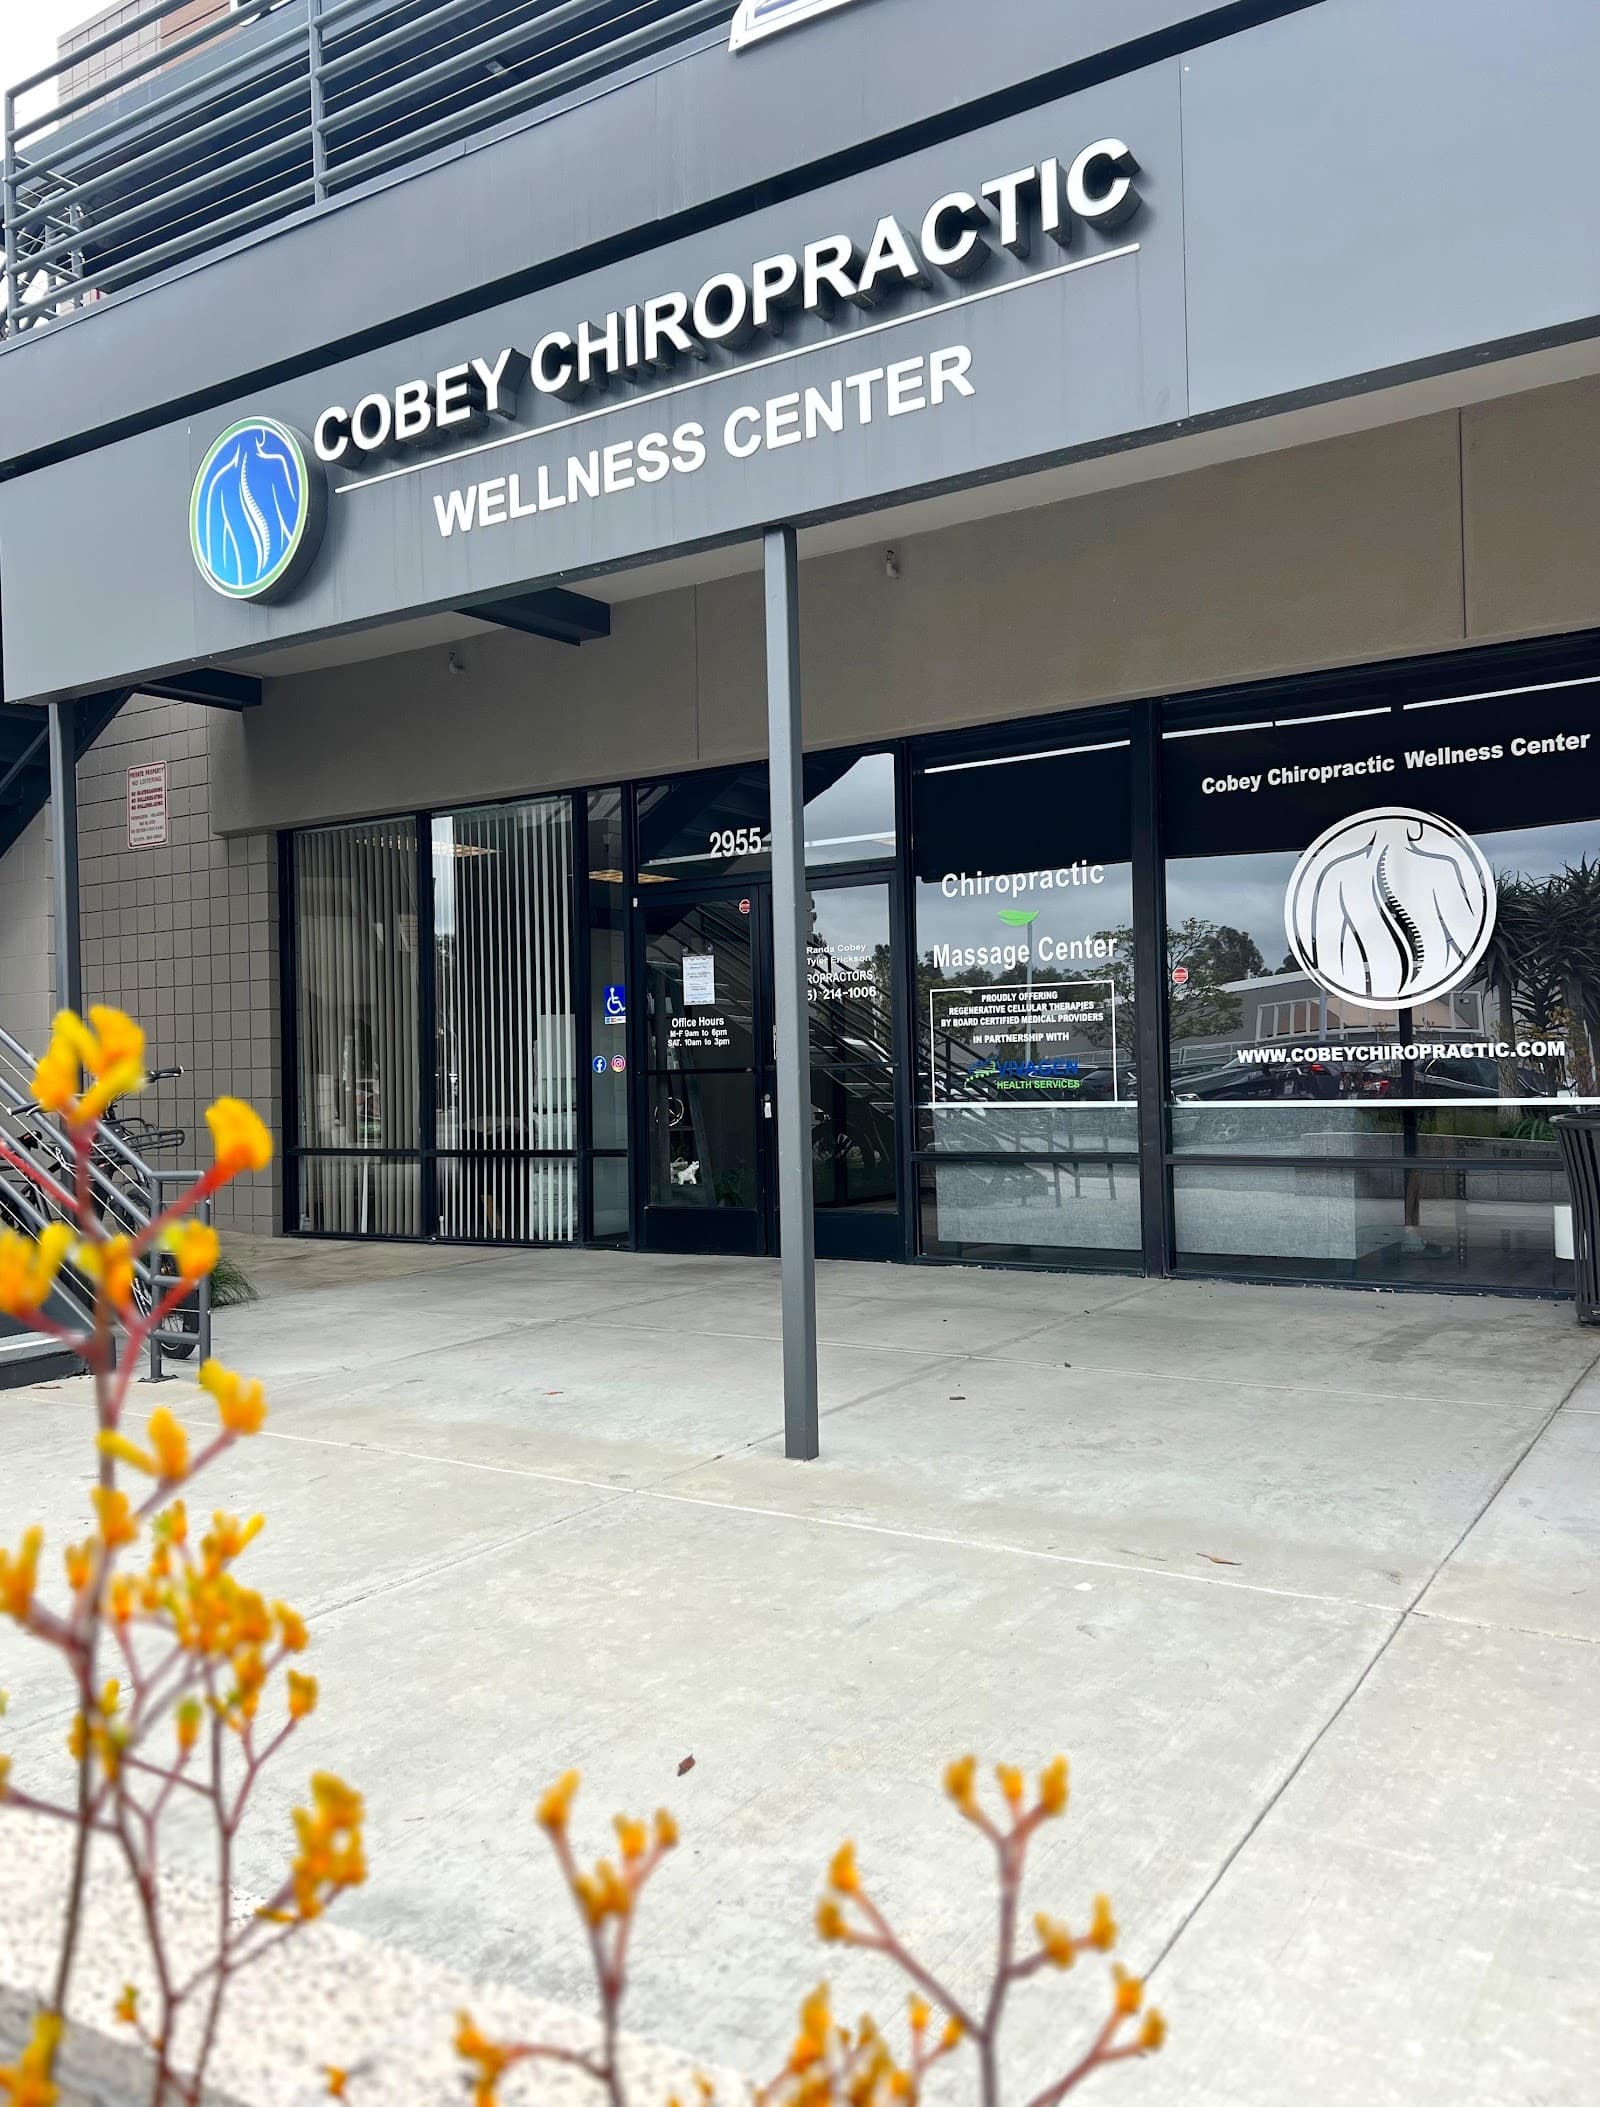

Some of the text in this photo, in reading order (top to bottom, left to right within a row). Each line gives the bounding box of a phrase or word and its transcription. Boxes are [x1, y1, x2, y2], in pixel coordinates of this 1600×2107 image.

[313, 137, 1131, 462] COBEY CHIROPRACTIC
[433, 345, 976, 537] WELLNESS CENTER
[1201, 731, 1591, 794] Cobey Chiropractic Wellness Center
[709, 826, 762, 858] 2955
[941, 859, 1105, 898] Chiropractic
[806, 944, 866, 954] Randa Cobey
[933, 934, 1118, 970] Massage Center
[806, 955, 871, 967] Tyler Erickson
[822, 986, 877, 1000] 214-1006
[981, 991, 1058, 1003] PROUDLY OFFERING
[948, 1001, 1095, 1016] REGENERATIVE CELLULAR THERAPIES
[671, 1016, 725, 1028] Office Hours
[941, 1012, 1104, 1027] BY BOARD CERTIFIED MEDICAL PROVIDERS
[669, 1028, 728, 1038] M-F 9am to 6pm
[973, 1032, 1070, 1044] IN PARTNERSHIP WITH
[667, 1037, 731, 1047] SAT. 10am to 3pm
[1237, 1040, 1566, 1064] WWW.COBEYCHIROPRACTIC.COM
[996, 1079, 1081, 1090] HEALTH SERVICES
